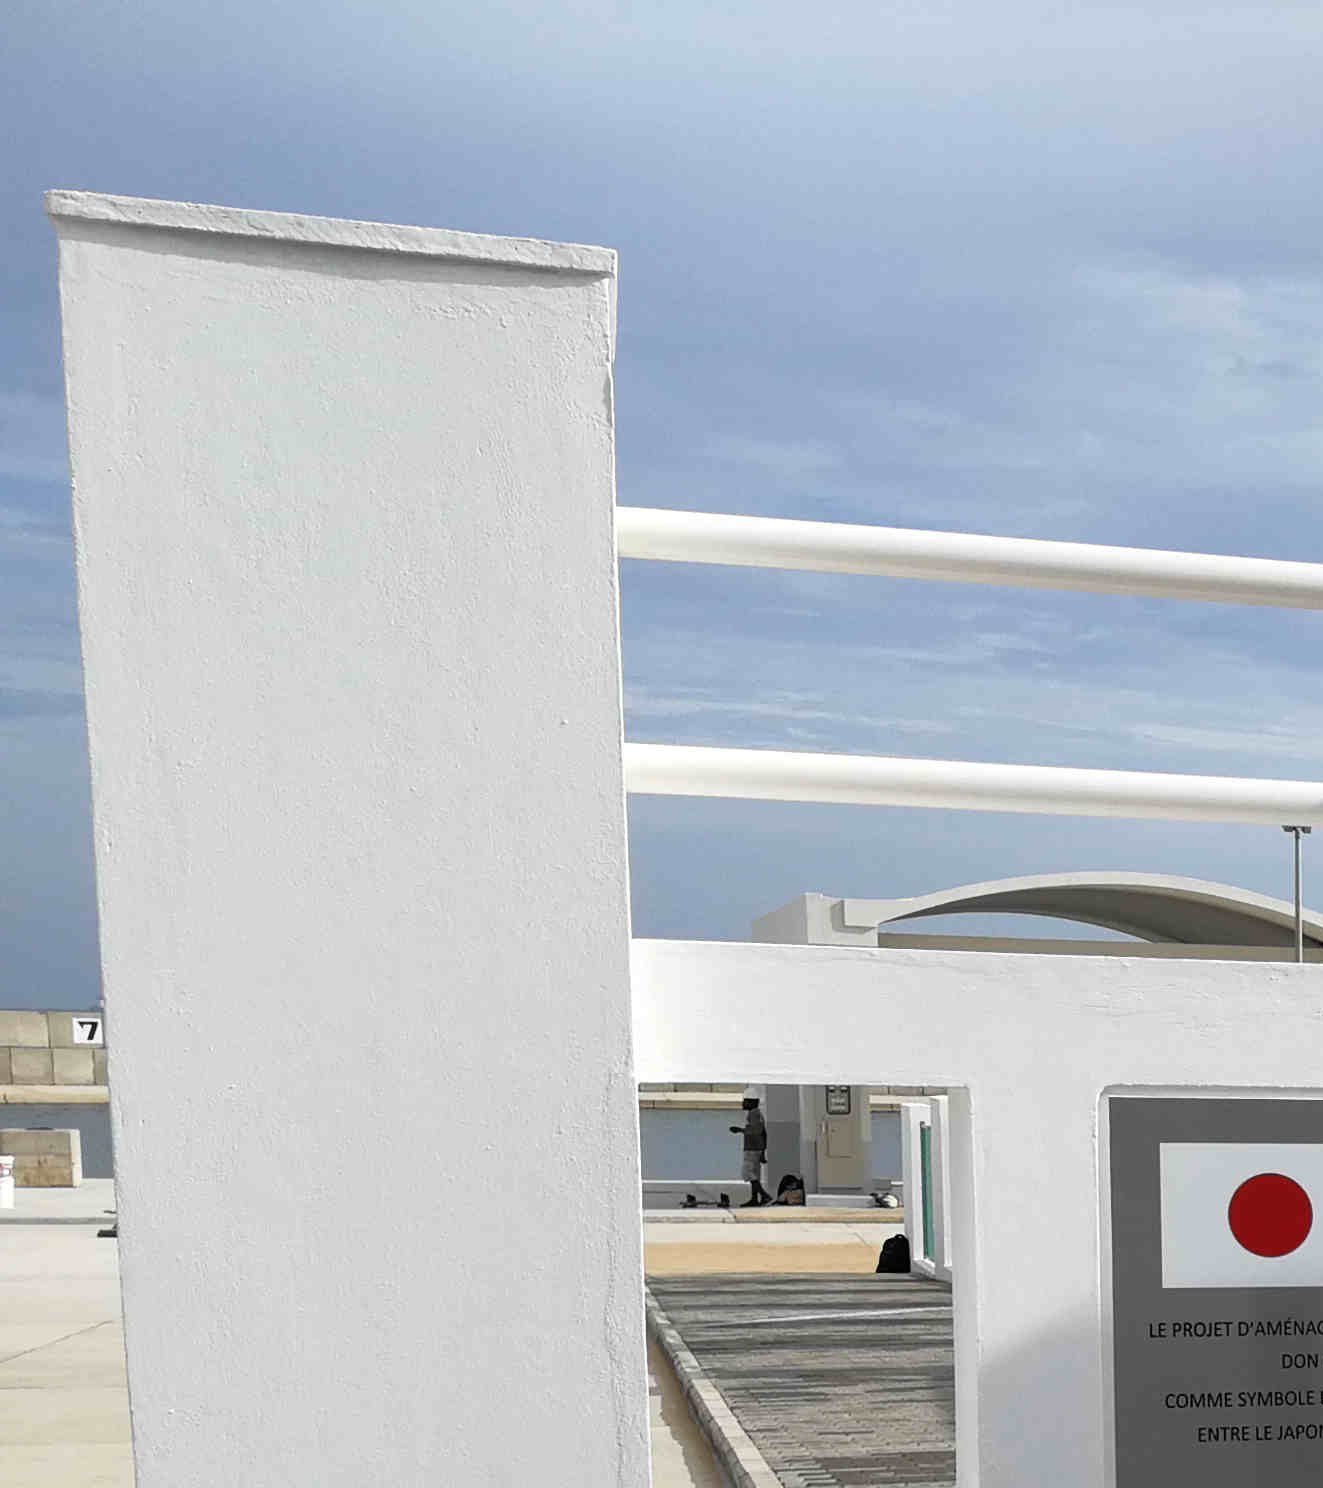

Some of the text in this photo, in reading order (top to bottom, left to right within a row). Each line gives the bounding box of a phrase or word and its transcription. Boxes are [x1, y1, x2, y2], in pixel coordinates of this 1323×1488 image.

[78, 1021, 99, 1040] 7
[1149, 1322, 1167, 1339] LE
[1172, 1321, 1234, 1338] PROJET
[1281, 1353, 1319, 1369] DON
[1164, 1391, 1233, 1409] COMME
[1237, 1389, 1316, 1408] SYMBOLE
[1197, 1425, 1251, 1443] ENTRE
[1255, 1425, 1273, 1441] LE
